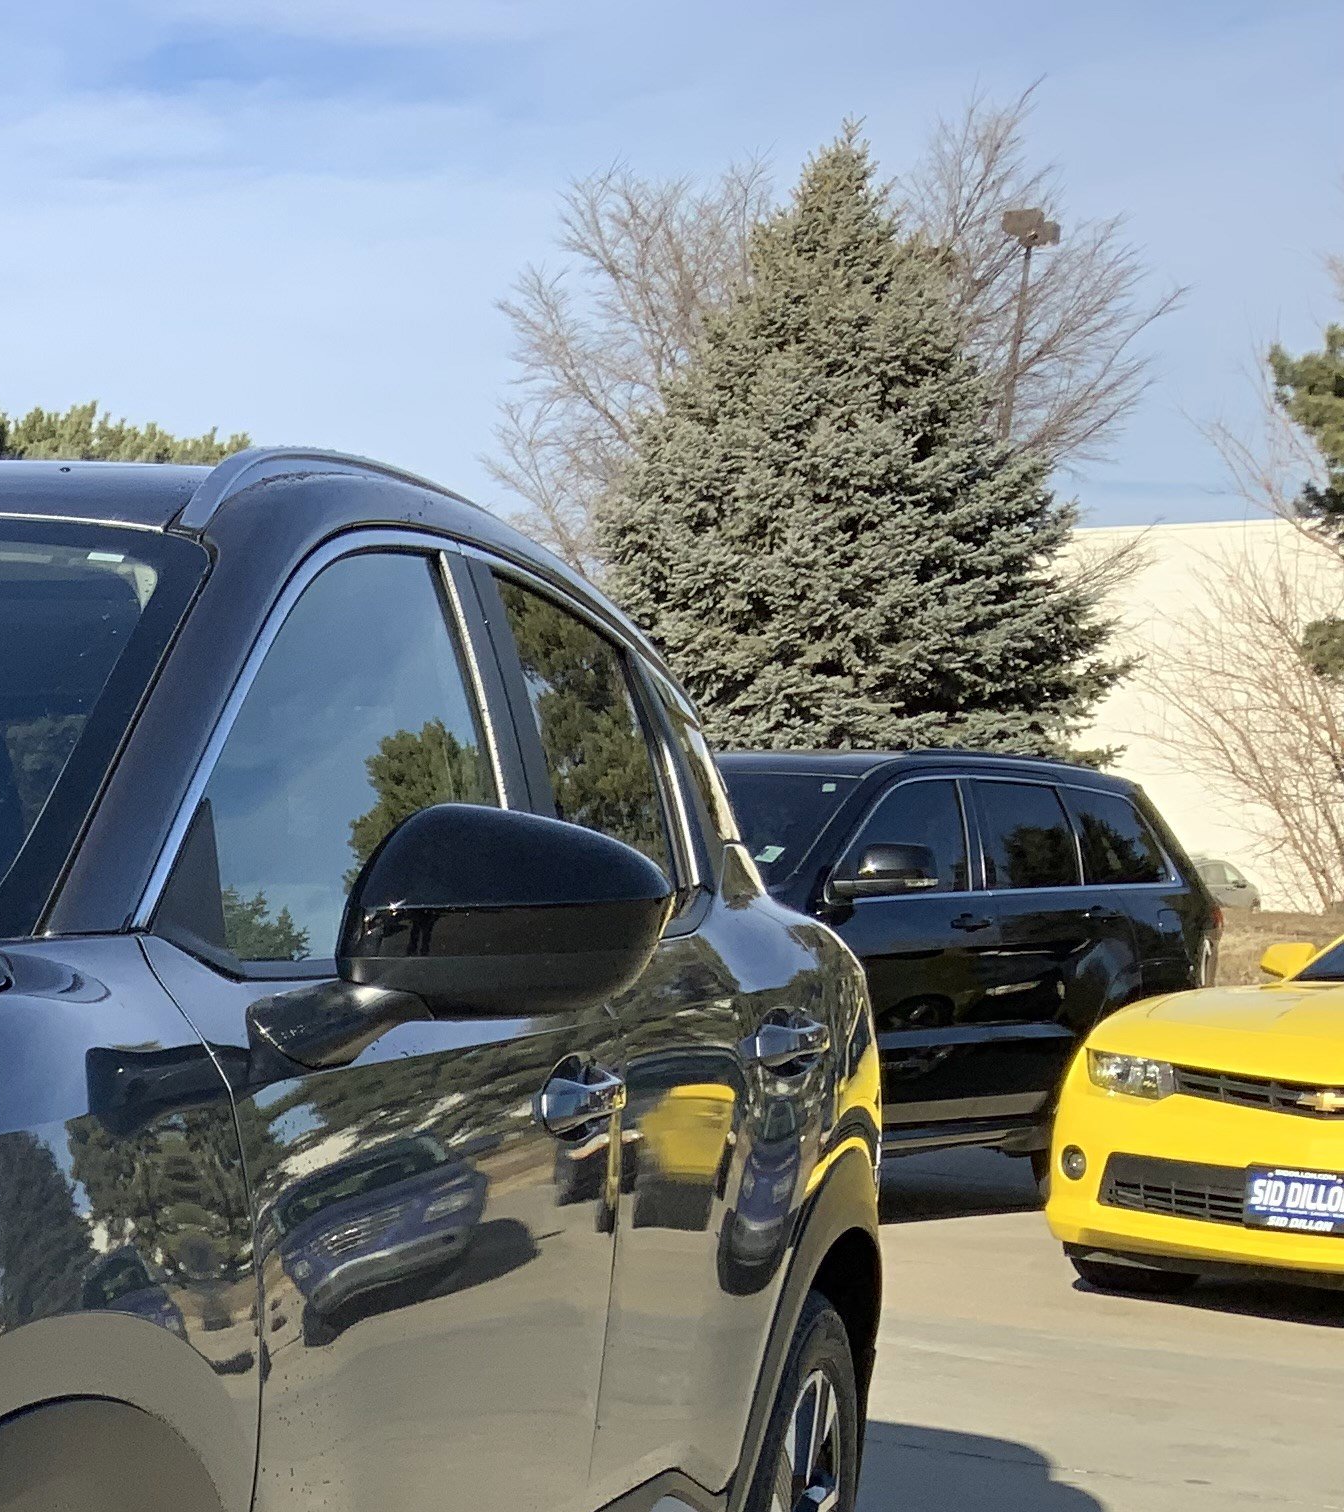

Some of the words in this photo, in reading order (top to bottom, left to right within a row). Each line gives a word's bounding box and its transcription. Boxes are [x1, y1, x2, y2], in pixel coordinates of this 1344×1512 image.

[1250, 1179, 1285, 1206] SID
[1286, 1182, 1344, 1212] DILLO
[1267, 1216, 1288, 1227] SID
[1289, 1218, 1335, 1231] DILLON
